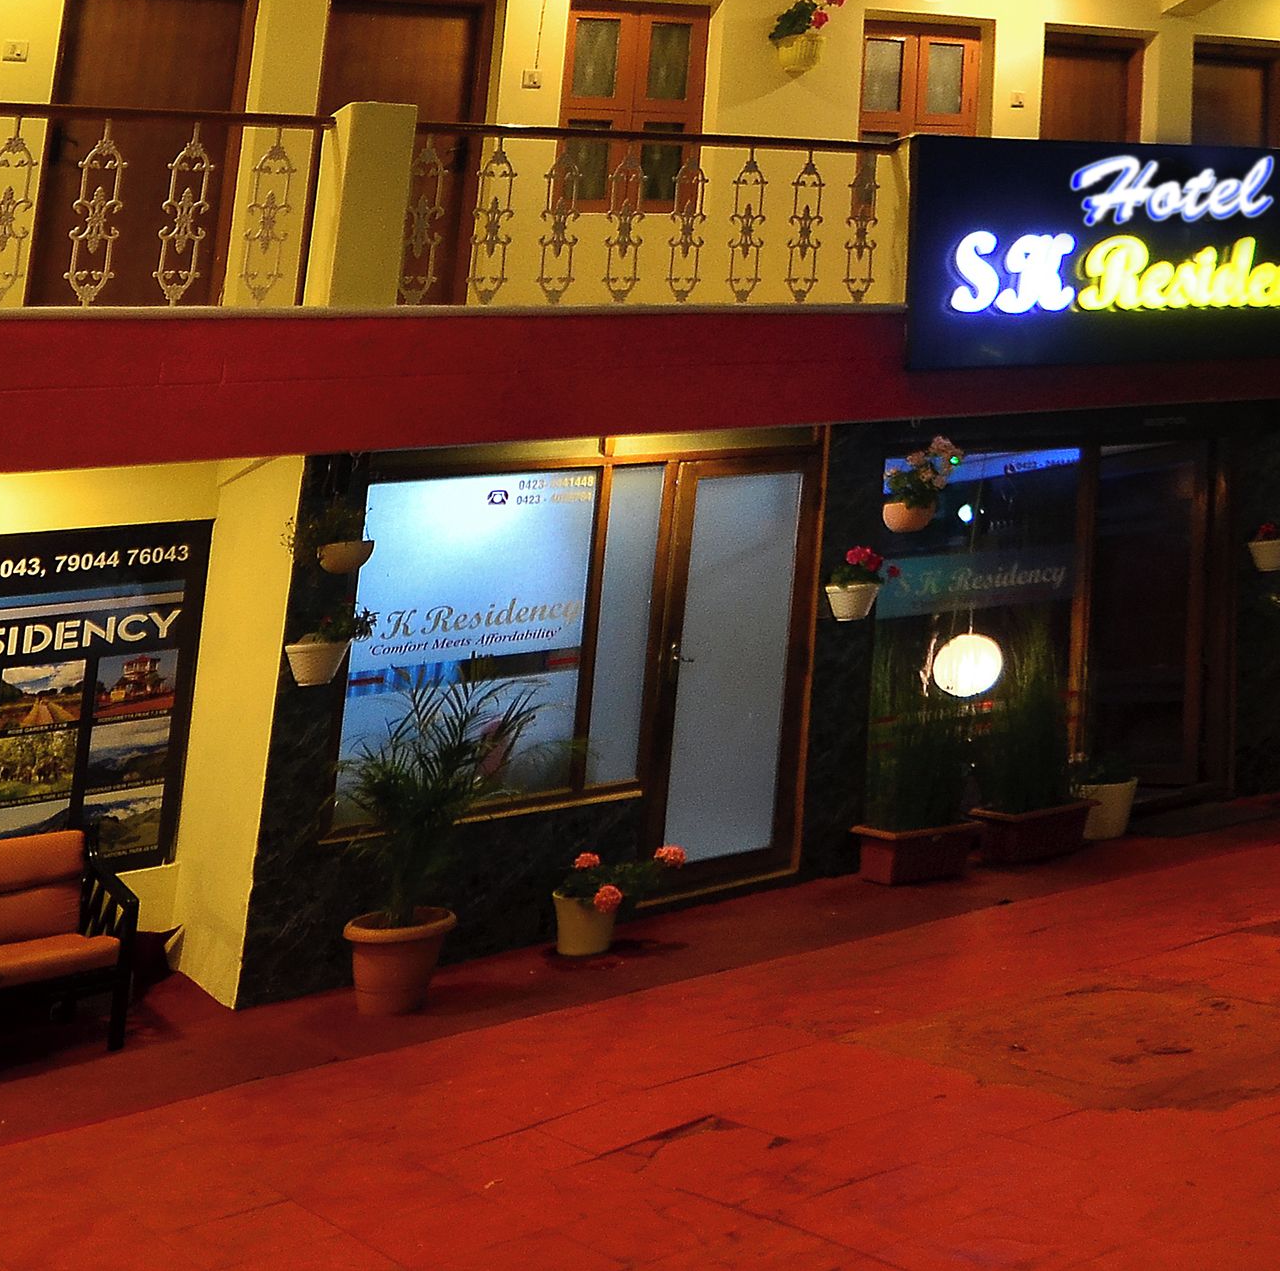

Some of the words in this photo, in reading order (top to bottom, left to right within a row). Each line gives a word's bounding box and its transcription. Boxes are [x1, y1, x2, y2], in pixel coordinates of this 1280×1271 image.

[1071, 155, 1275, 226] Hotel
[54, 551, 120, 572] 79044
[127, 544, 190, 566] 76043
[948, 563, 1067, 593] Residency
[420, 597, 582, 635] Residency
[431, 637, 471, 650] Meets
